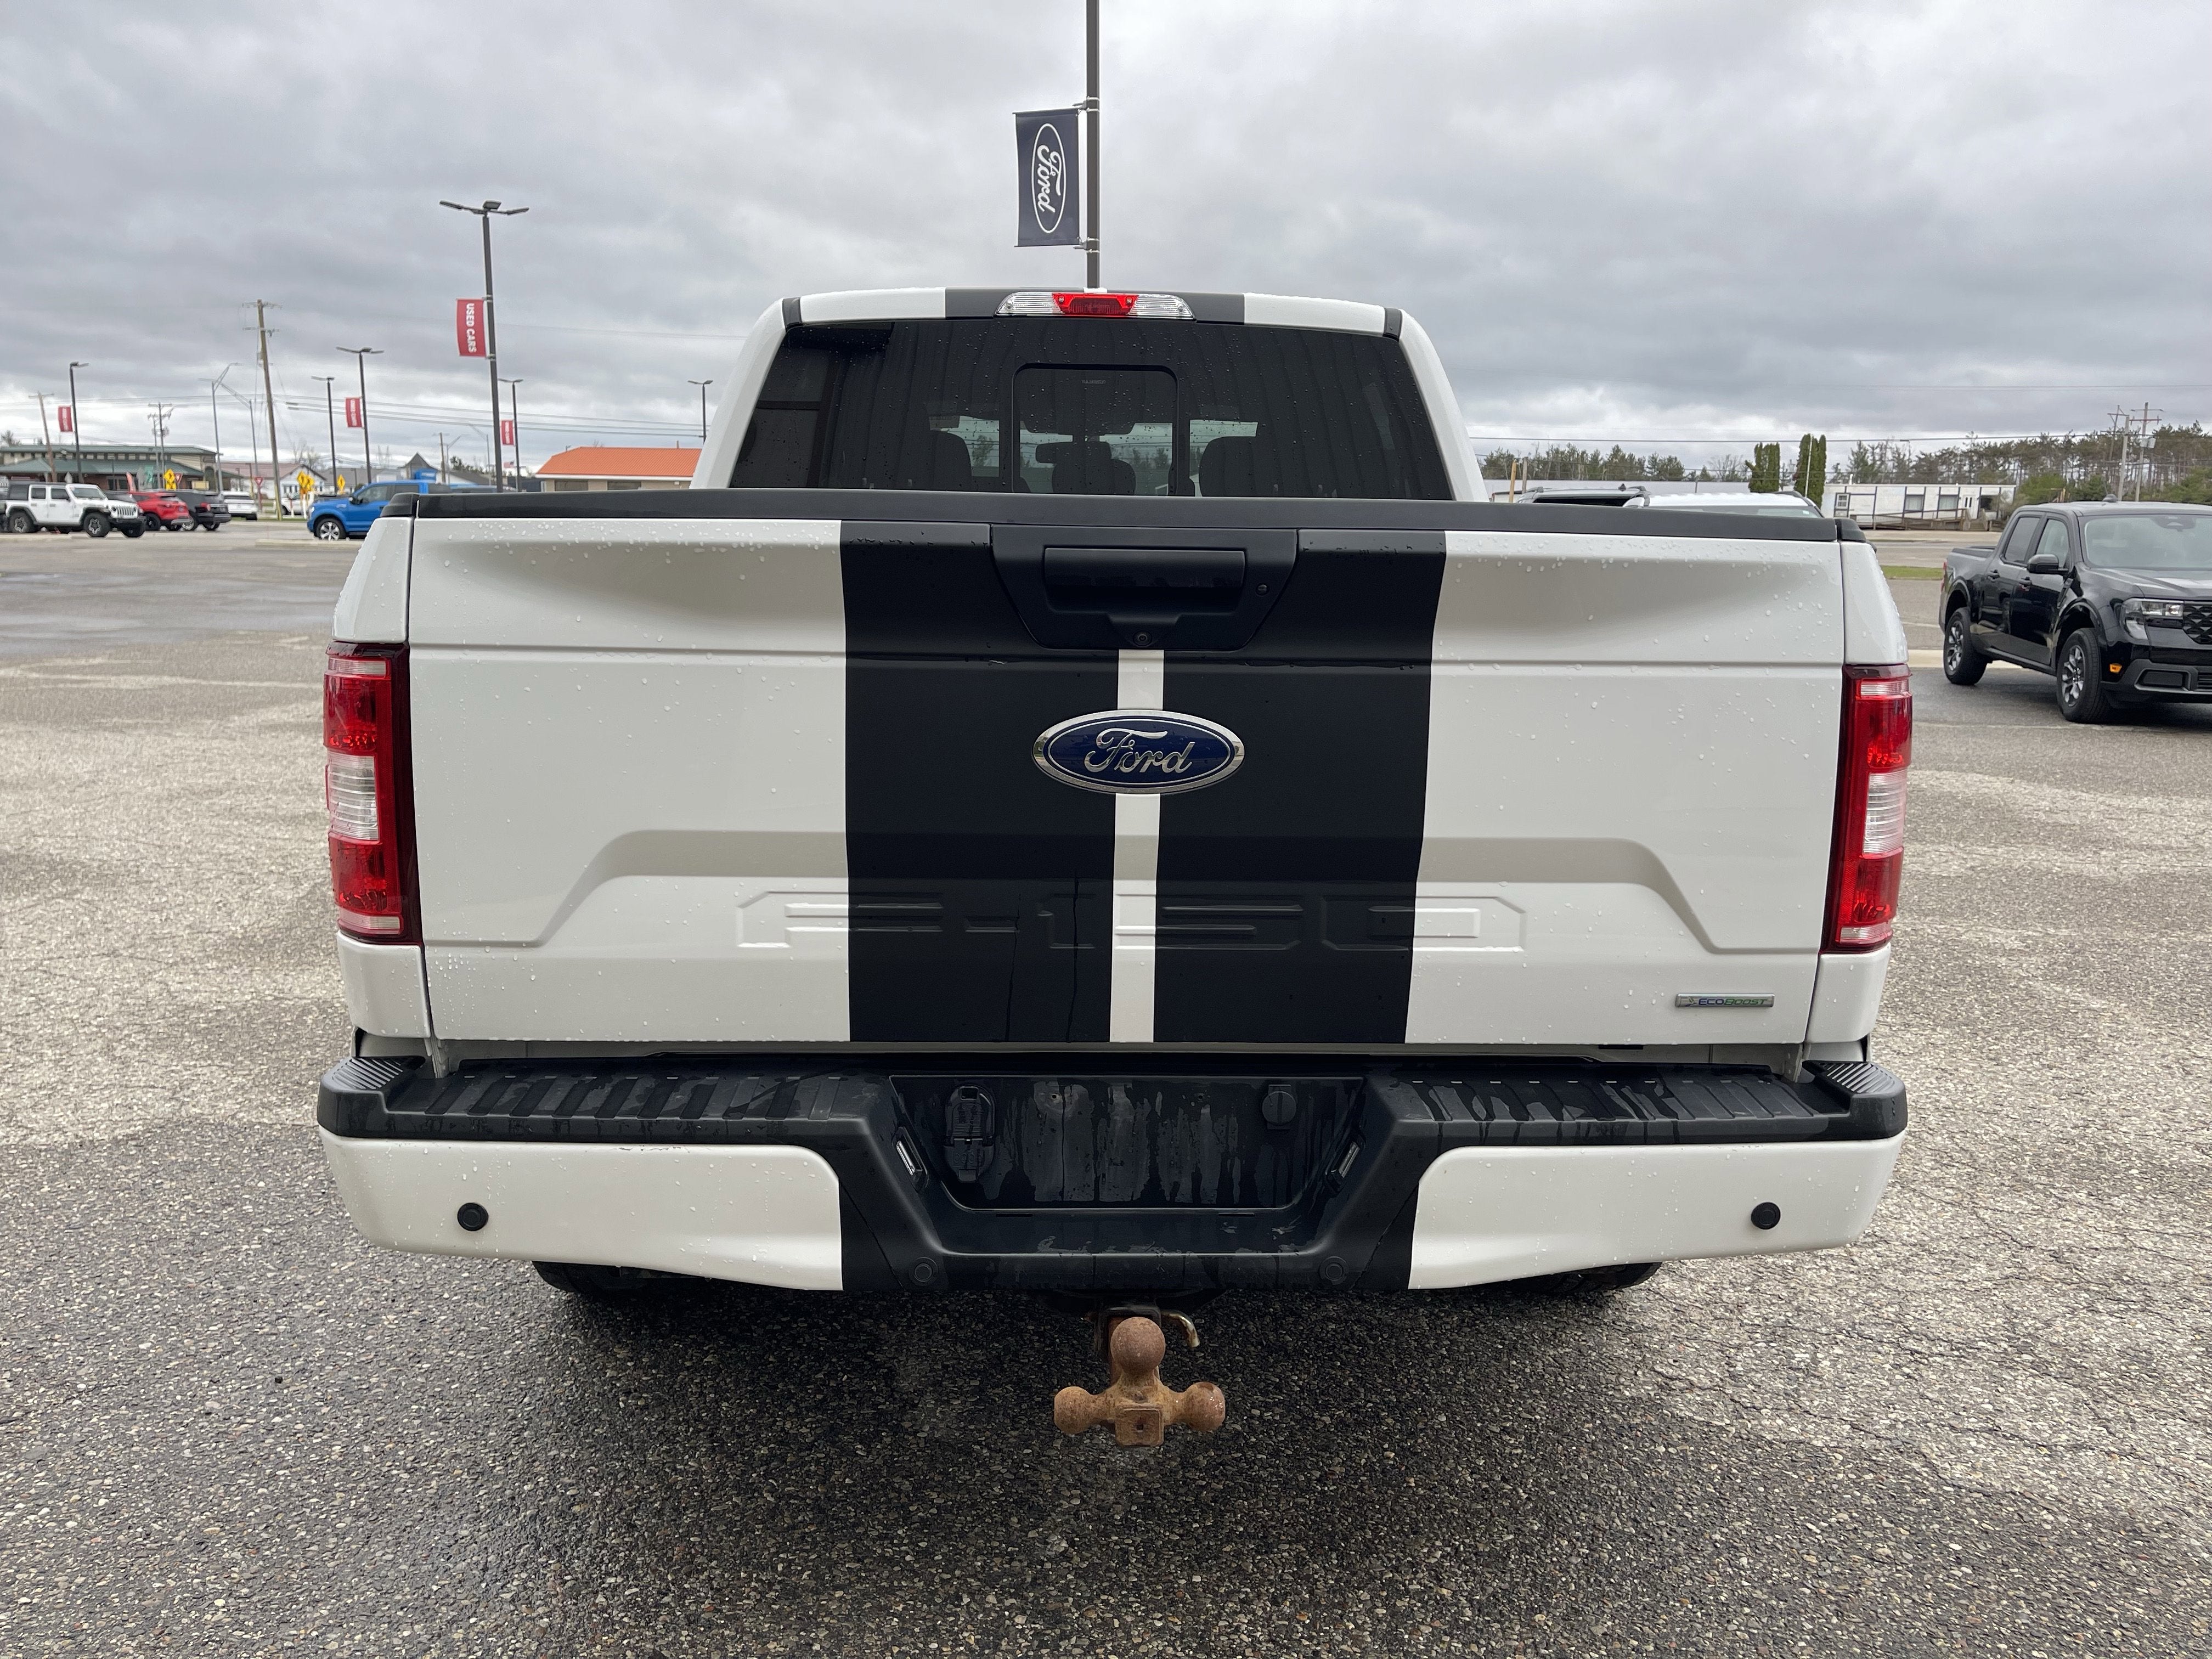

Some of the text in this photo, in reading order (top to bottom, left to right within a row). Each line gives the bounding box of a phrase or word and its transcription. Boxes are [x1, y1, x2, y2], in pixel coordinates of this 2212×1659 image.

[1037, 144, 1061, 213] Ford
[466, 303, 477, 353] USED CARS
[1084, 727, 1195, 774] Ford
